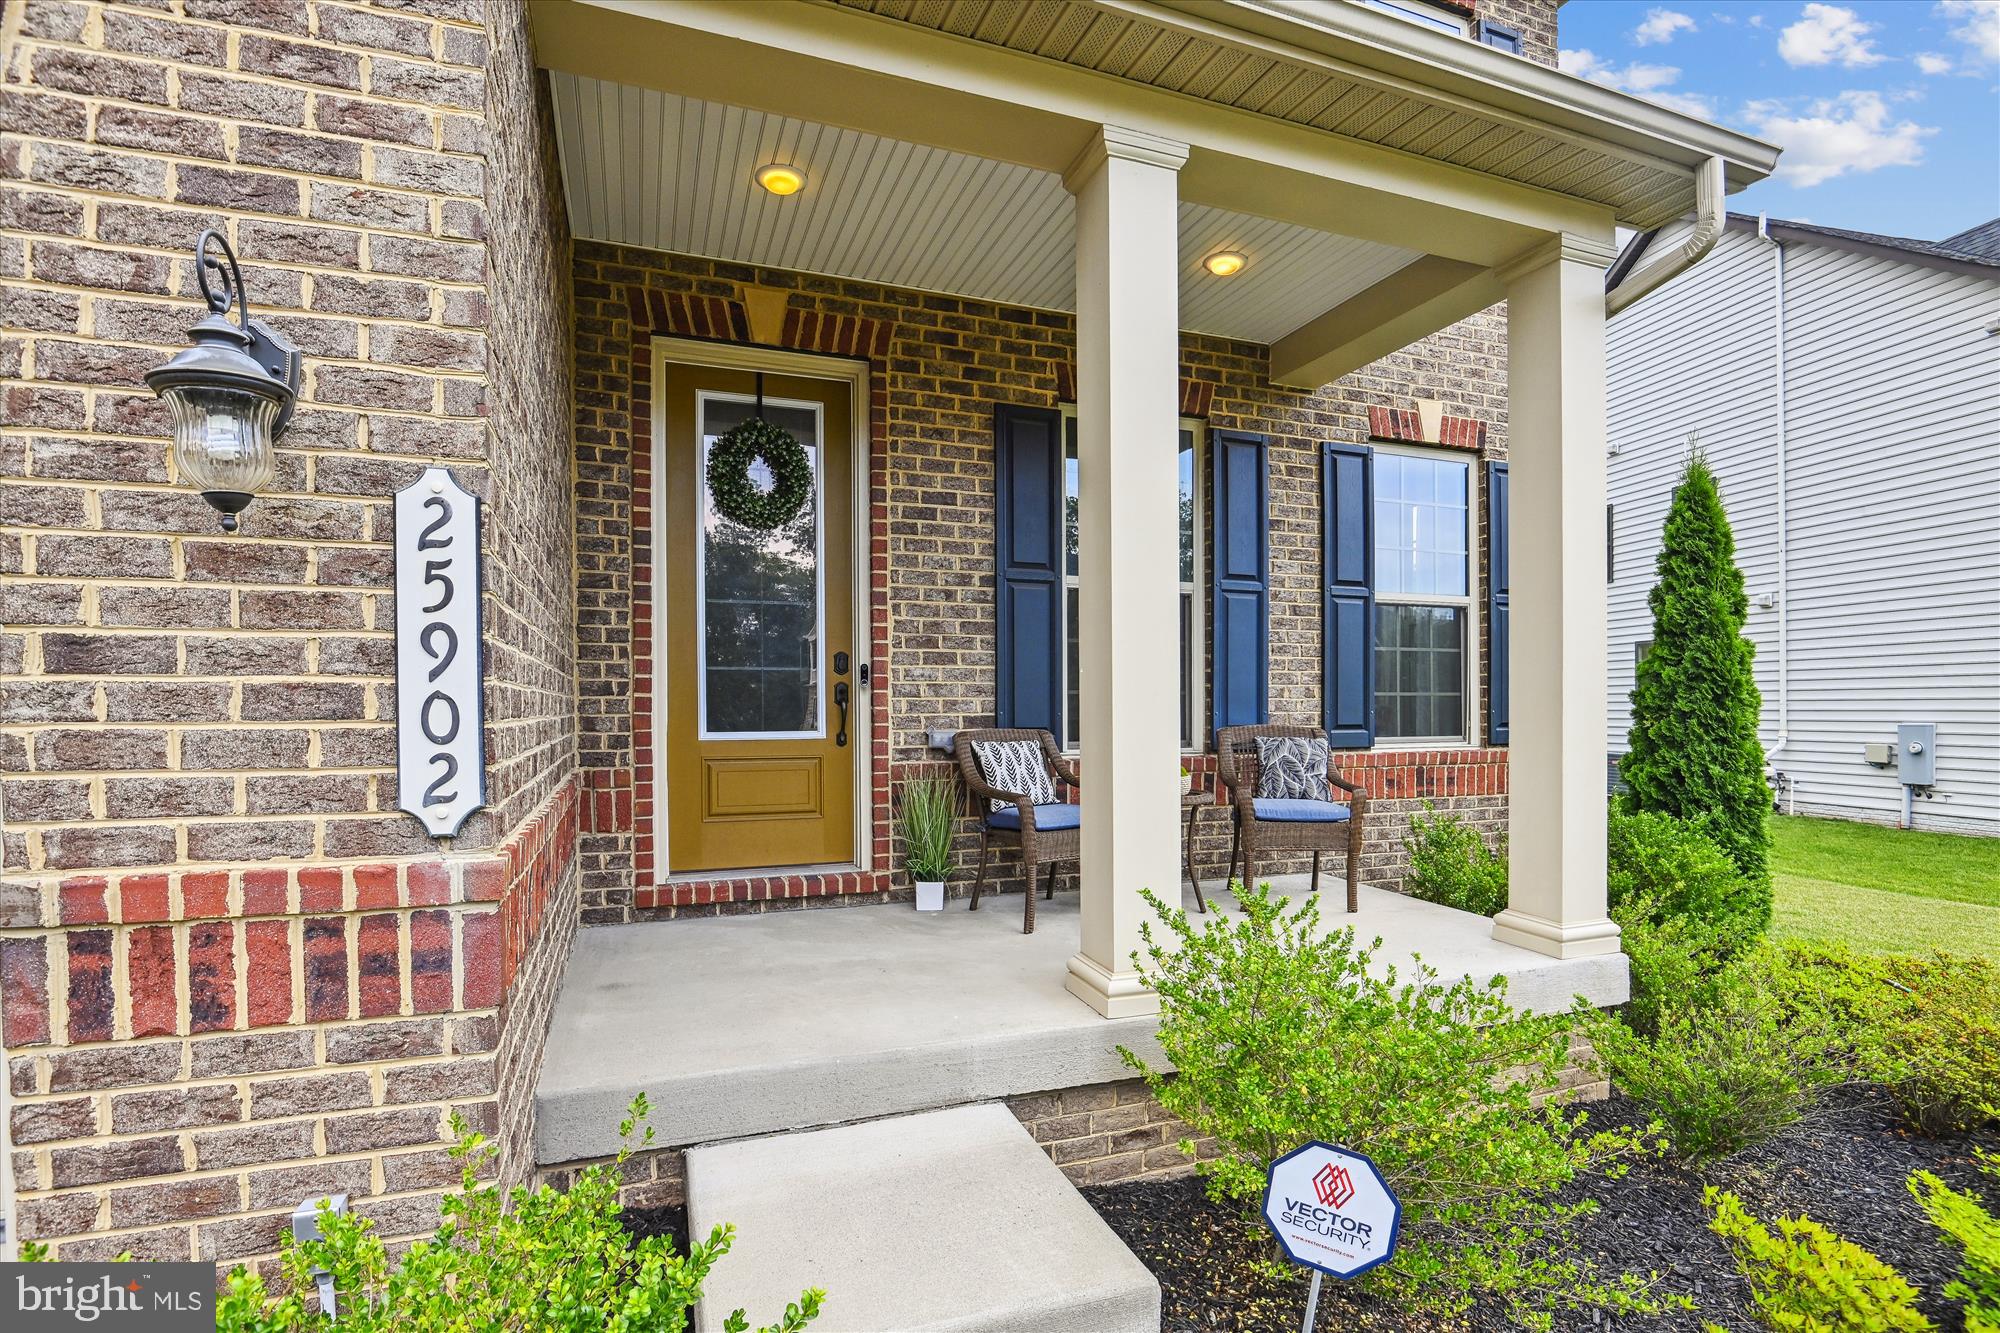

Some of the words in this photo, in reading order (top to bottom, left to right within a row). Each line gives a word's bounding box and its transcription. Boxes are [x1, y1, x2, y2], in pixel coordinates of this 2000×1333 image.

[418, 497, 460, 807] 25902
[1280, 1211, 1371, 1250] SECURITY
[1285, 1197, 1372, 1238] VECTOR
[1291, 1233, 1355, 1260] www.vectorsecurity.com
